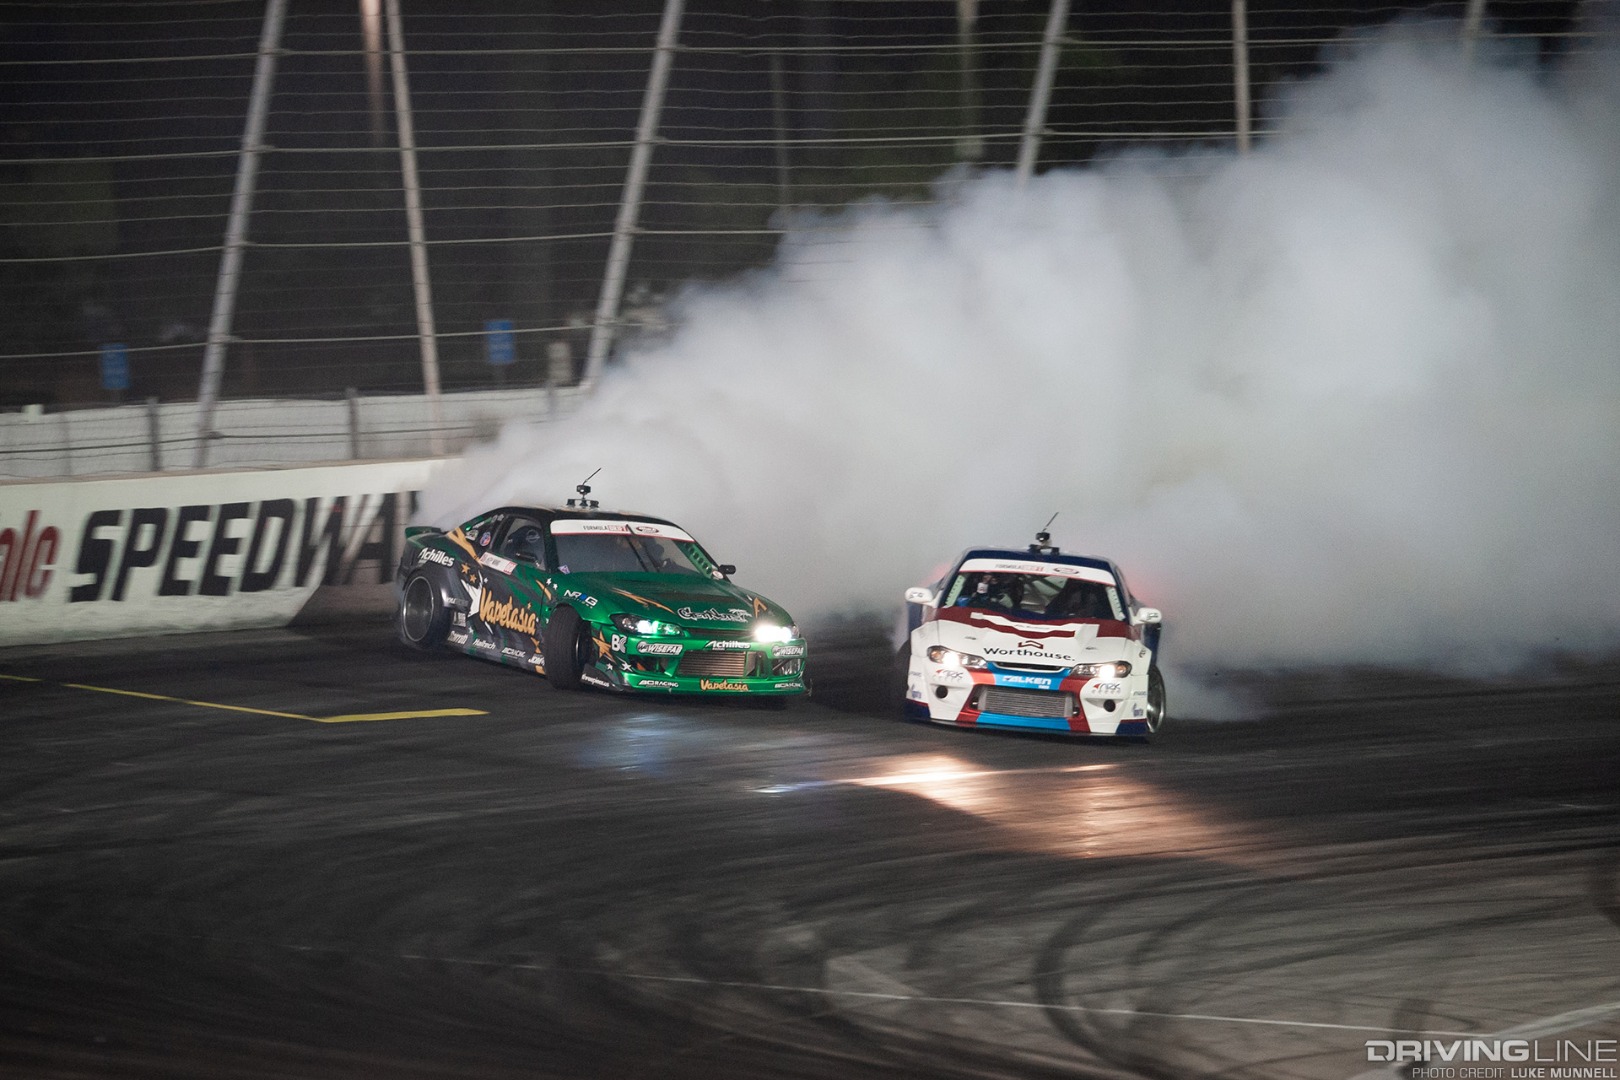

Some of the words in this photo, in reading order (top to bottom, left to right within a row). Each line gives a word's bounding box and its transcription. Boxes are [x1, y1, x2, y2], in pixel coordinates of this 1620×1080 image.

[418, 547, 455, 567] Achilles
[480, 587, 536, 635] Vapetasia
[705, 640, 751, 649] Achilles
[701, 679, 749, 691] Vapetasia
